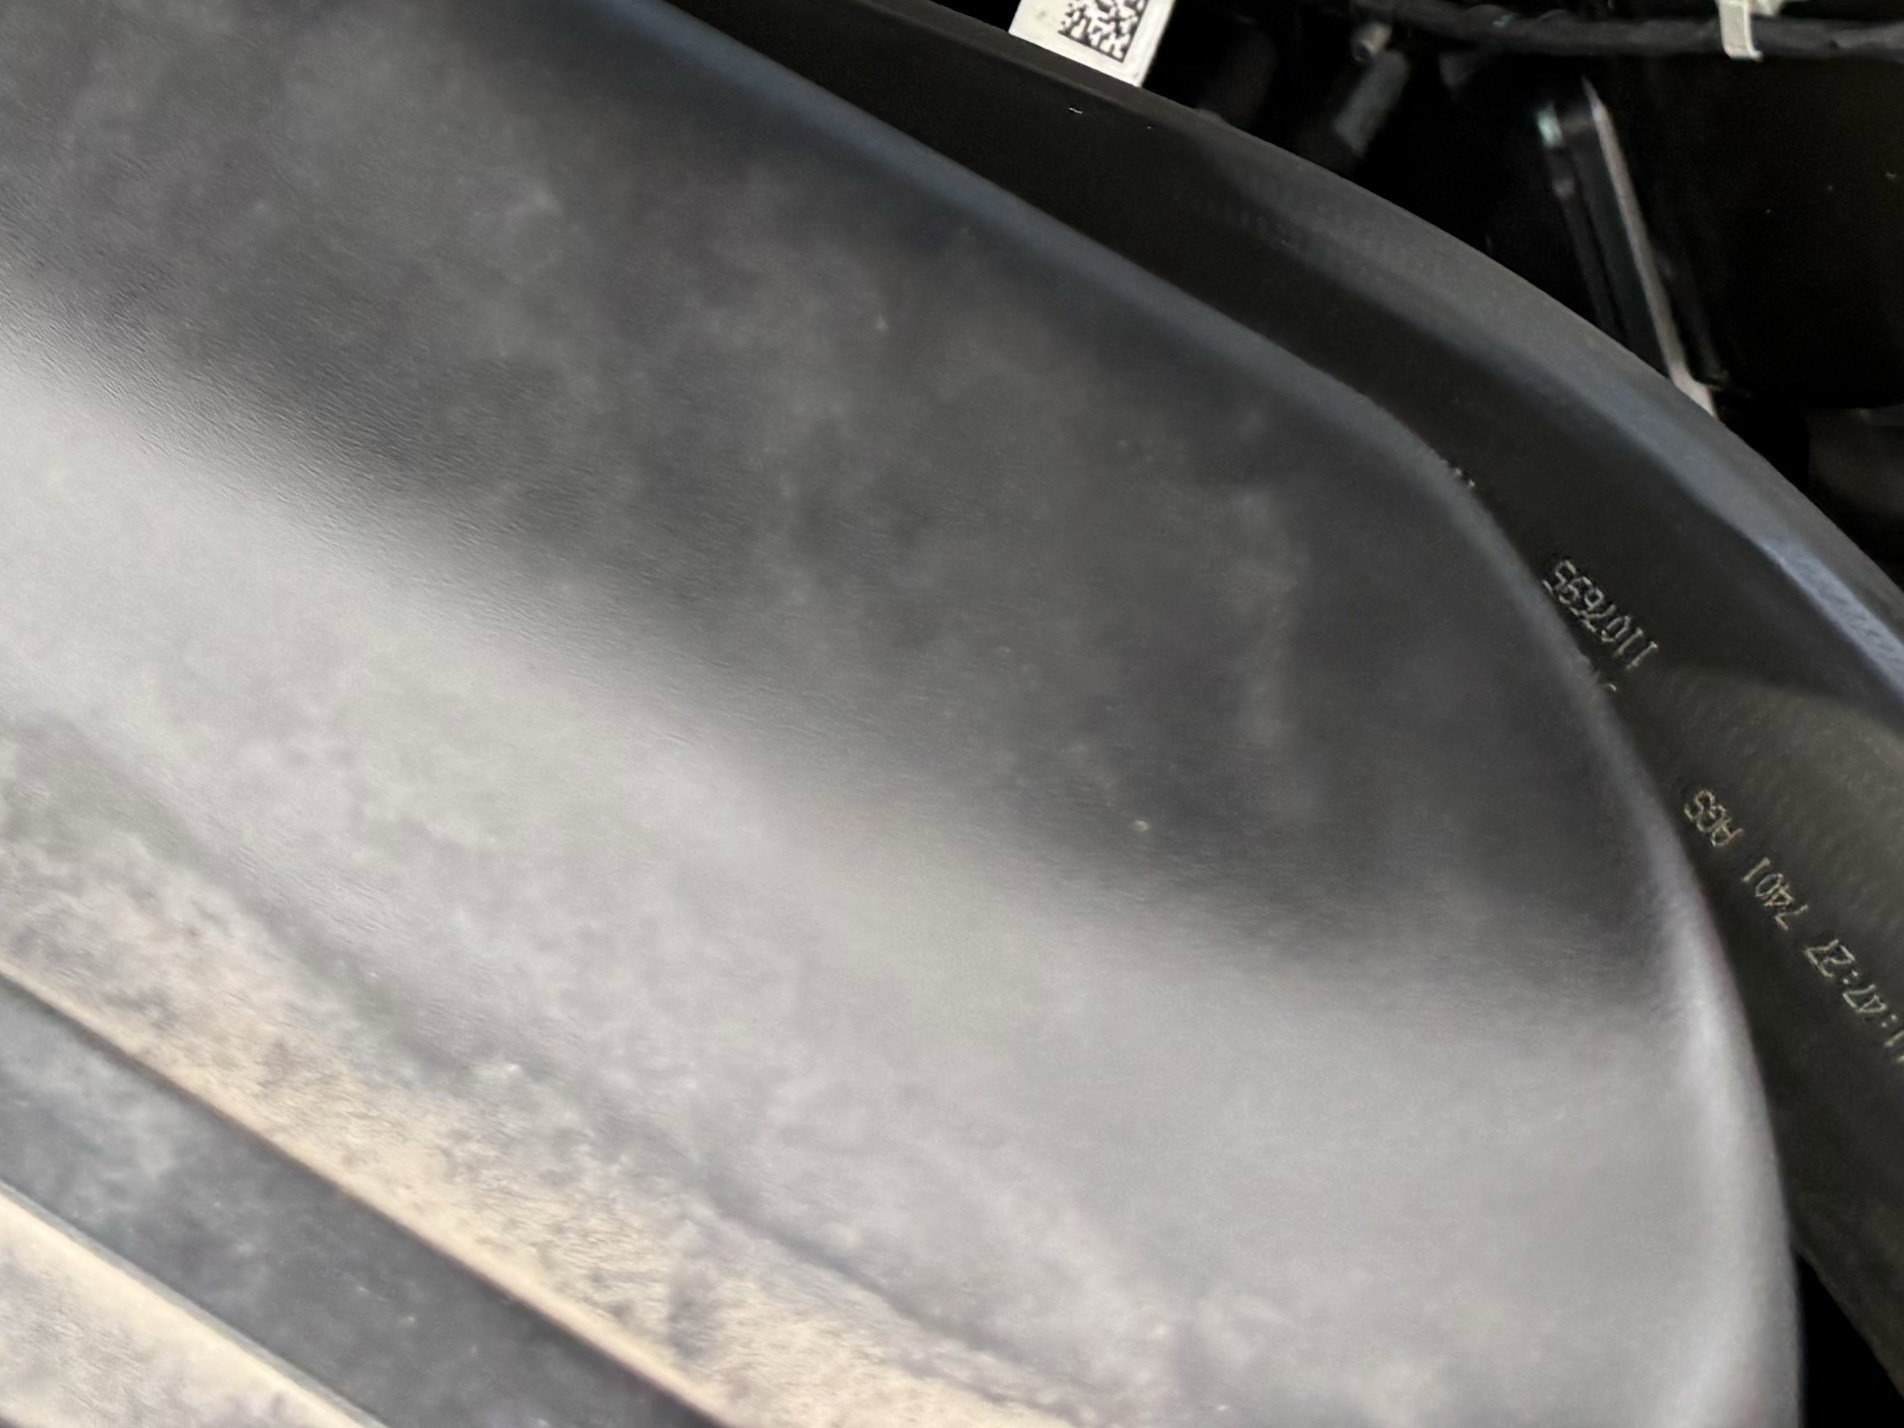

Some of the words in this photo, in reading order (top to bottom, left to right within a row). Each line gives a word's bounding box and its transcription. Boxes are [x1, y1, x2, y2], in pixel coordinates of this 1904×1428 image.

[1542, 559, 1659, 671] 1107695
[1683, 788, 1744, 847] AGS
[1740, 854, 1809, 932] 7401
